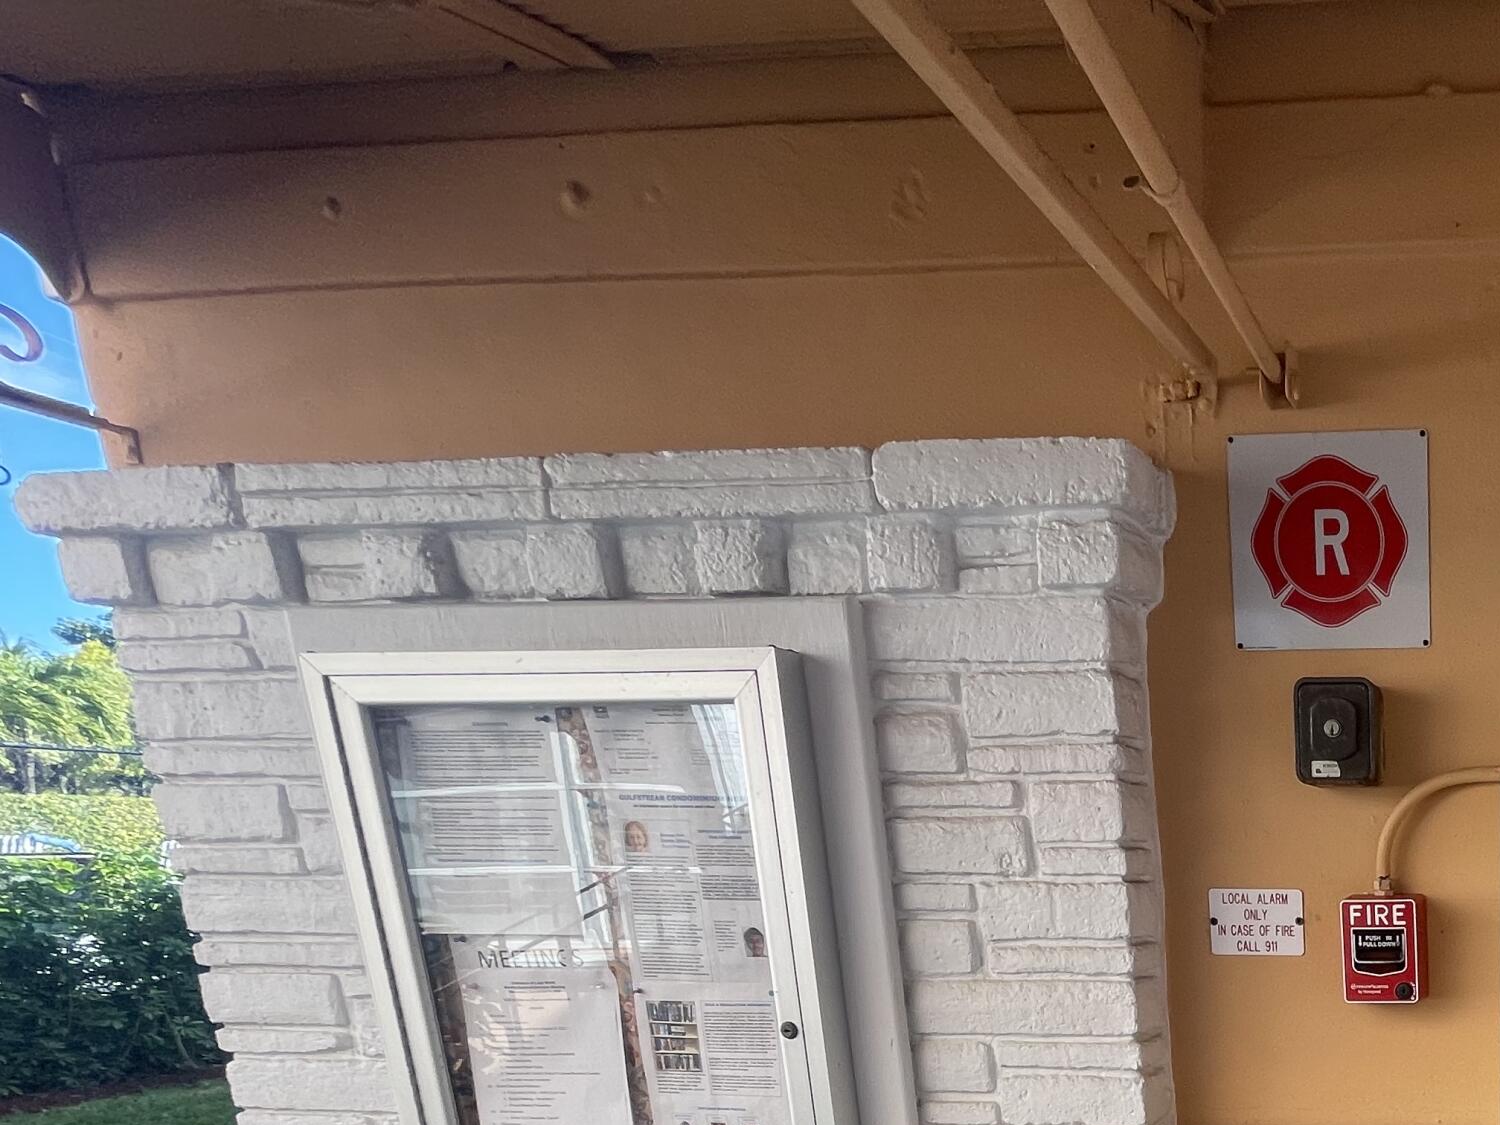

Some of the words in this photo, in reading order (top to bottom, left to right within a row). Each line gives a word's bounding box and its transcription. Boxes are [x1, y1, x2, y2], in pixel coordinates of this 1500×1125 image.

[1314, 508, 1350, 576] R
[1221, 892, 1252, 905] LOCAL
[1257, 892, 1289, 905] ALARM
[1243, 908, 1268, 921] ONLY
[1349, 904, 1407, 926] FIRE
[1217, 924, 1227, 936] IN
[1230, 924, 1254, 936] CASE
[1259, 924, 1271, 937] OF
[1275, 925, 1296, 937] FIRE
[1236, 940, 1261, 953] CALL
[1264, 940, 1278, 953] 911
